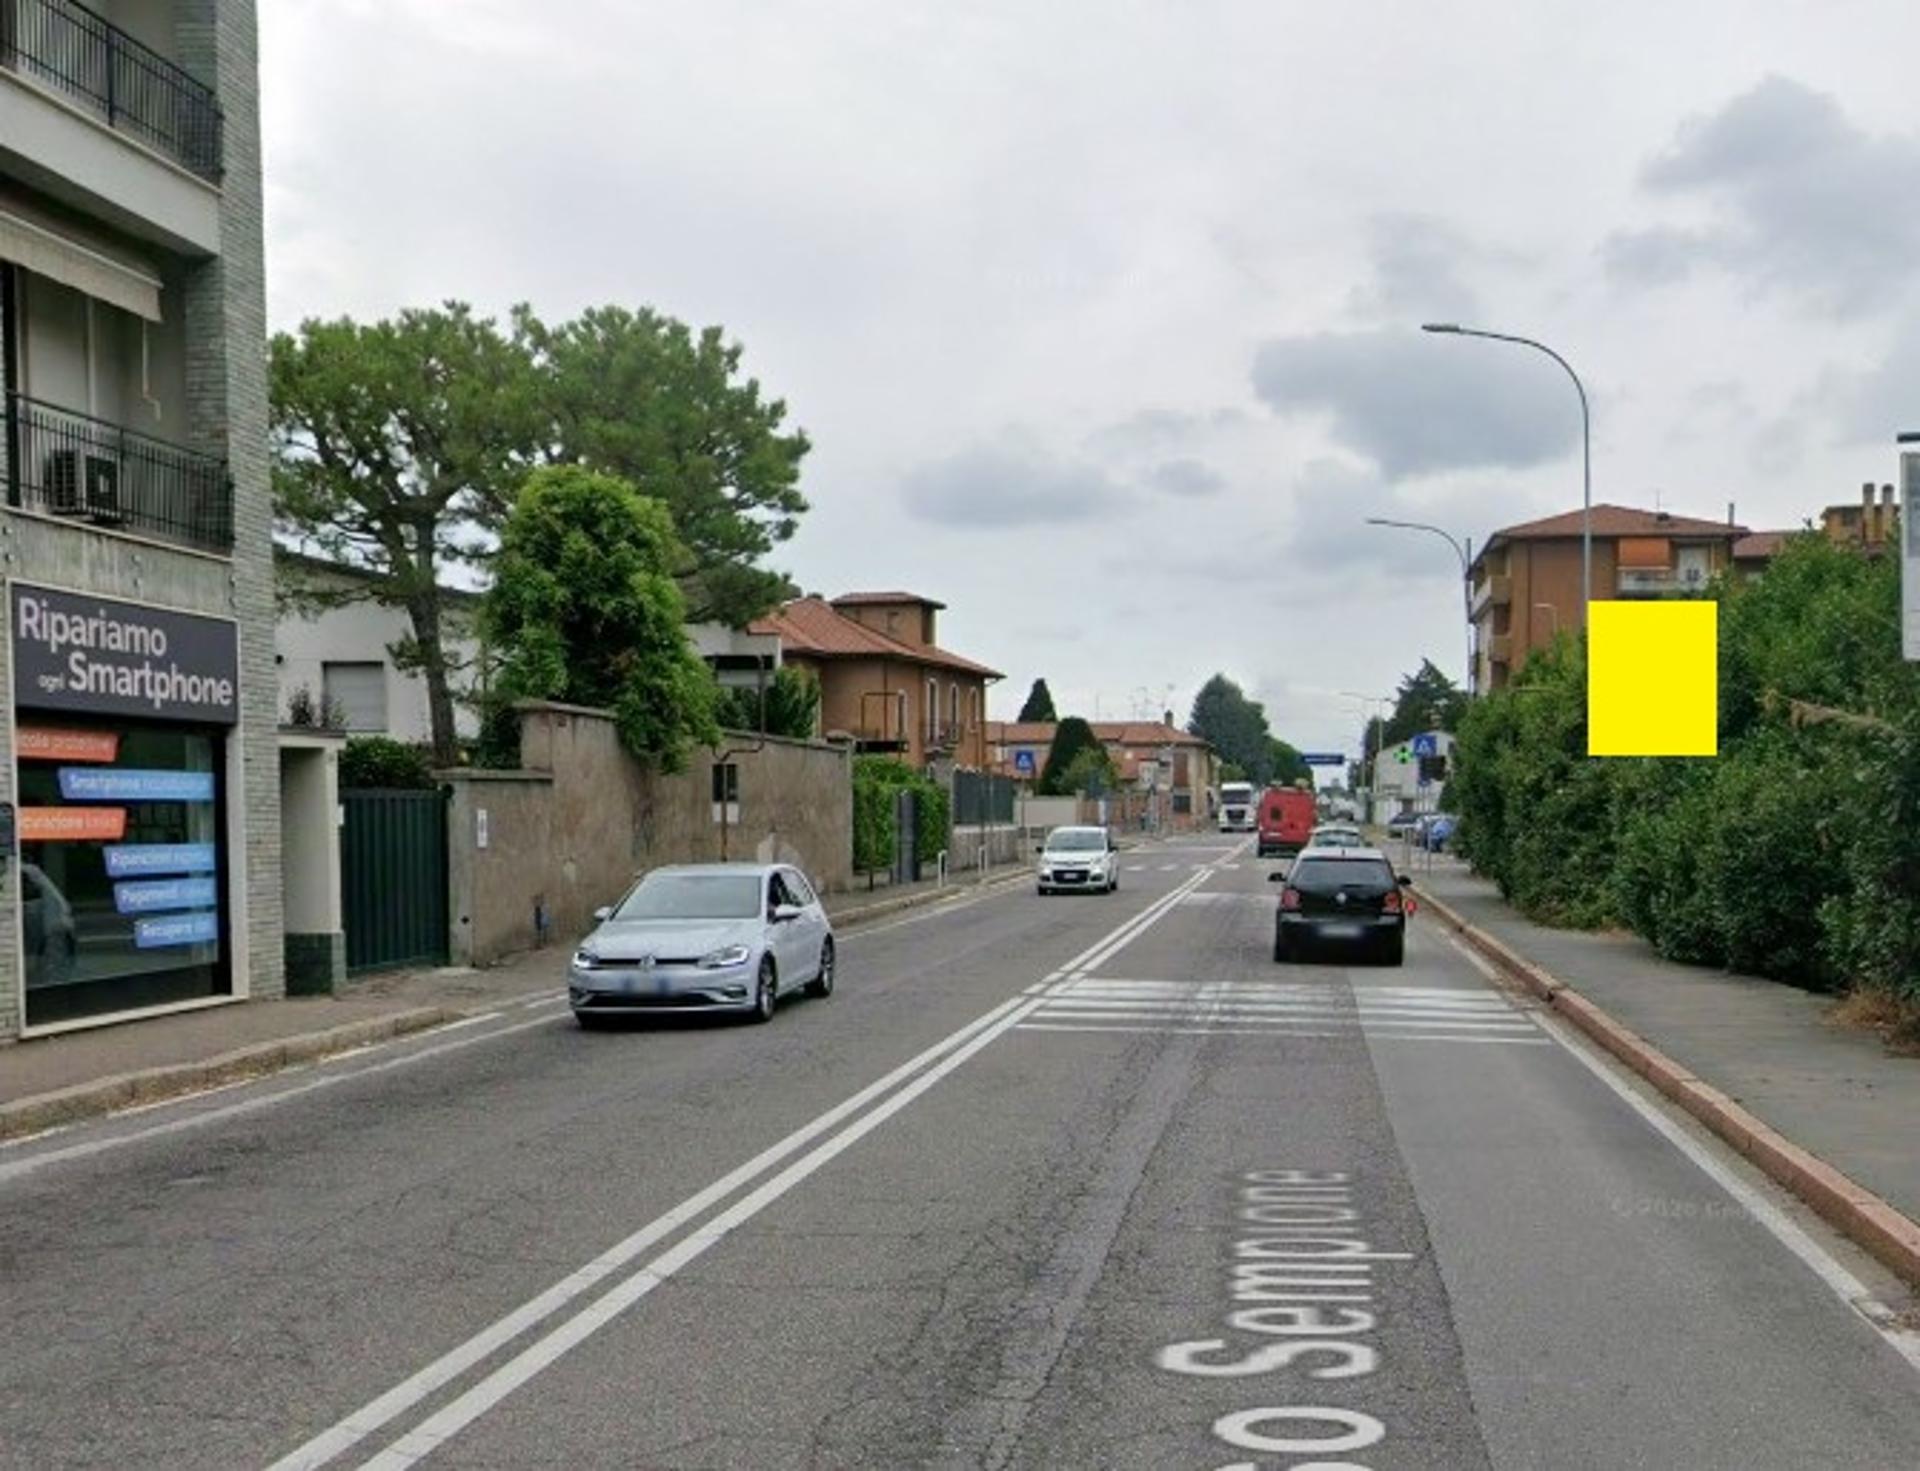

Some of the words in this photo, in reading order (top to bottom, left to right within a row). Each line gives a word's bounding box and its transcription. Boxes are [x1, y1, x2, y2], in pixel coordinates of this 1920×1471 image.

[18, 597, 168, 656] Ripariamo
[68, 650, 234, 709] Smartphone
[1158, 1169, 1415, 1377] Sempione
